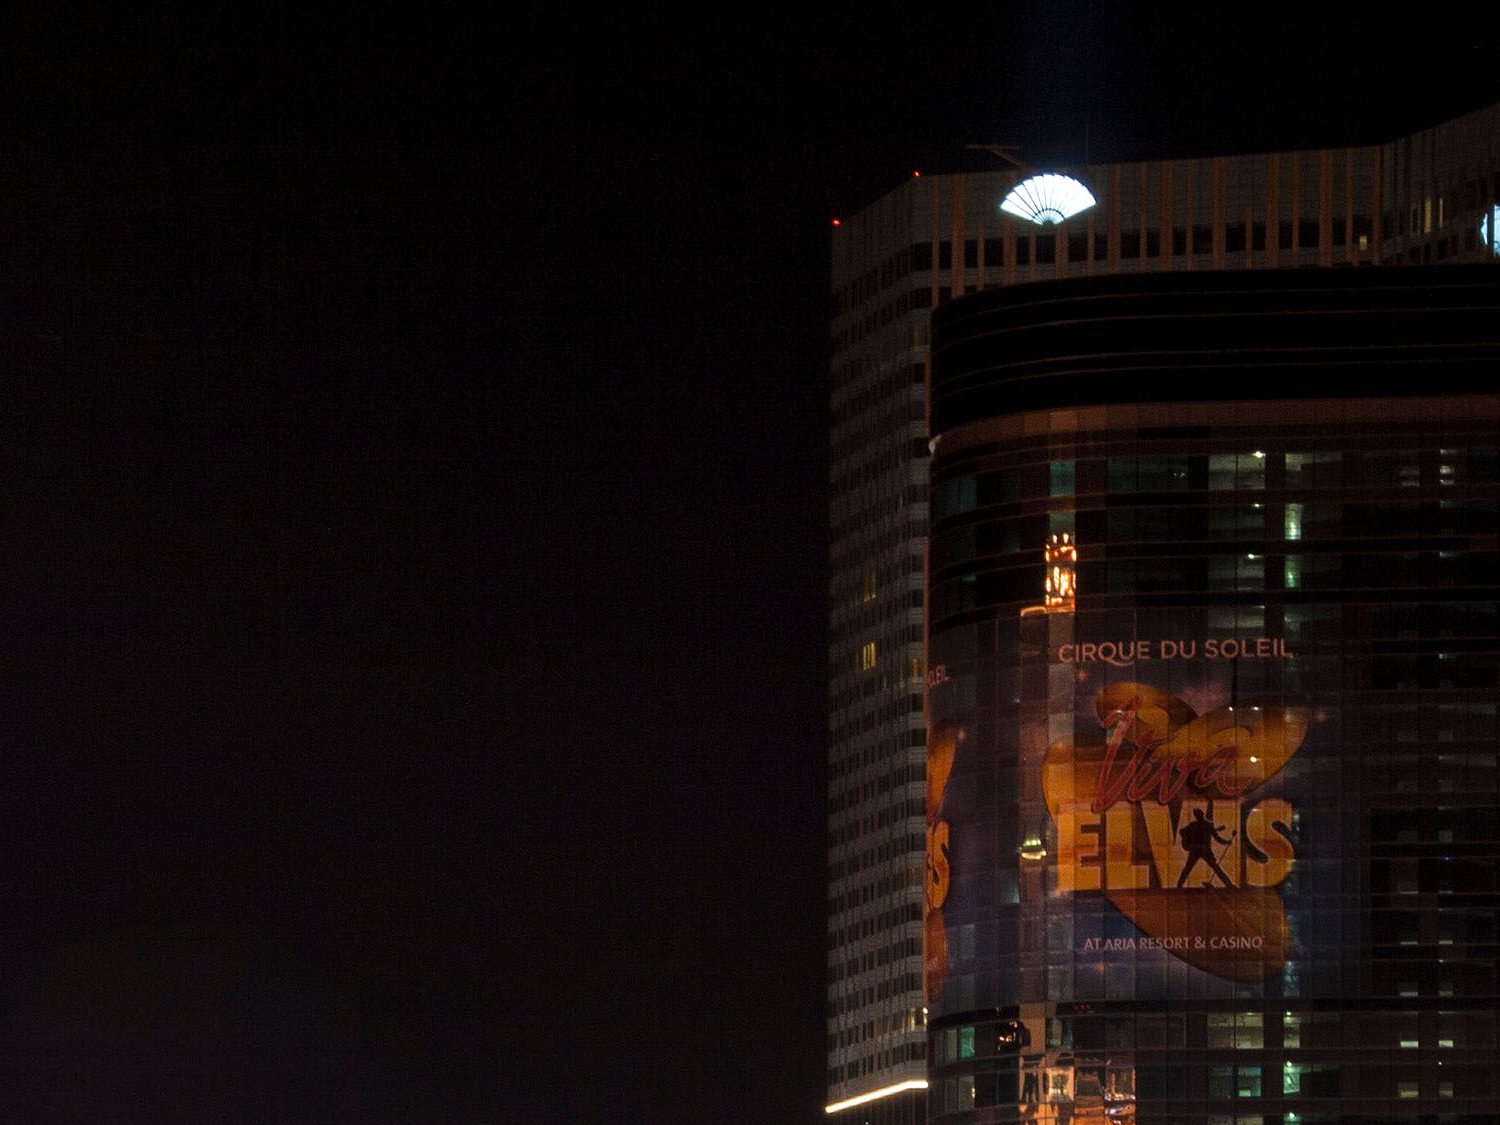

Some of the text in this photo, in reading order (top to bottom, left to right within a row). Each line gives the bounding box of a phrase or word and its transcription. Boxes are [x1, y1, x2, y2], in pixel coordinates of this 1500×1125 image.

[1058, 638, 1294, 667] CIRQUE DU SOLEIL
[1091, 695, 1246, 813] Viva
[1056, 797, 1295, 890] ELVIS
[1083, 935, 1263, 951] AT ARIA RESORT & CASINO
